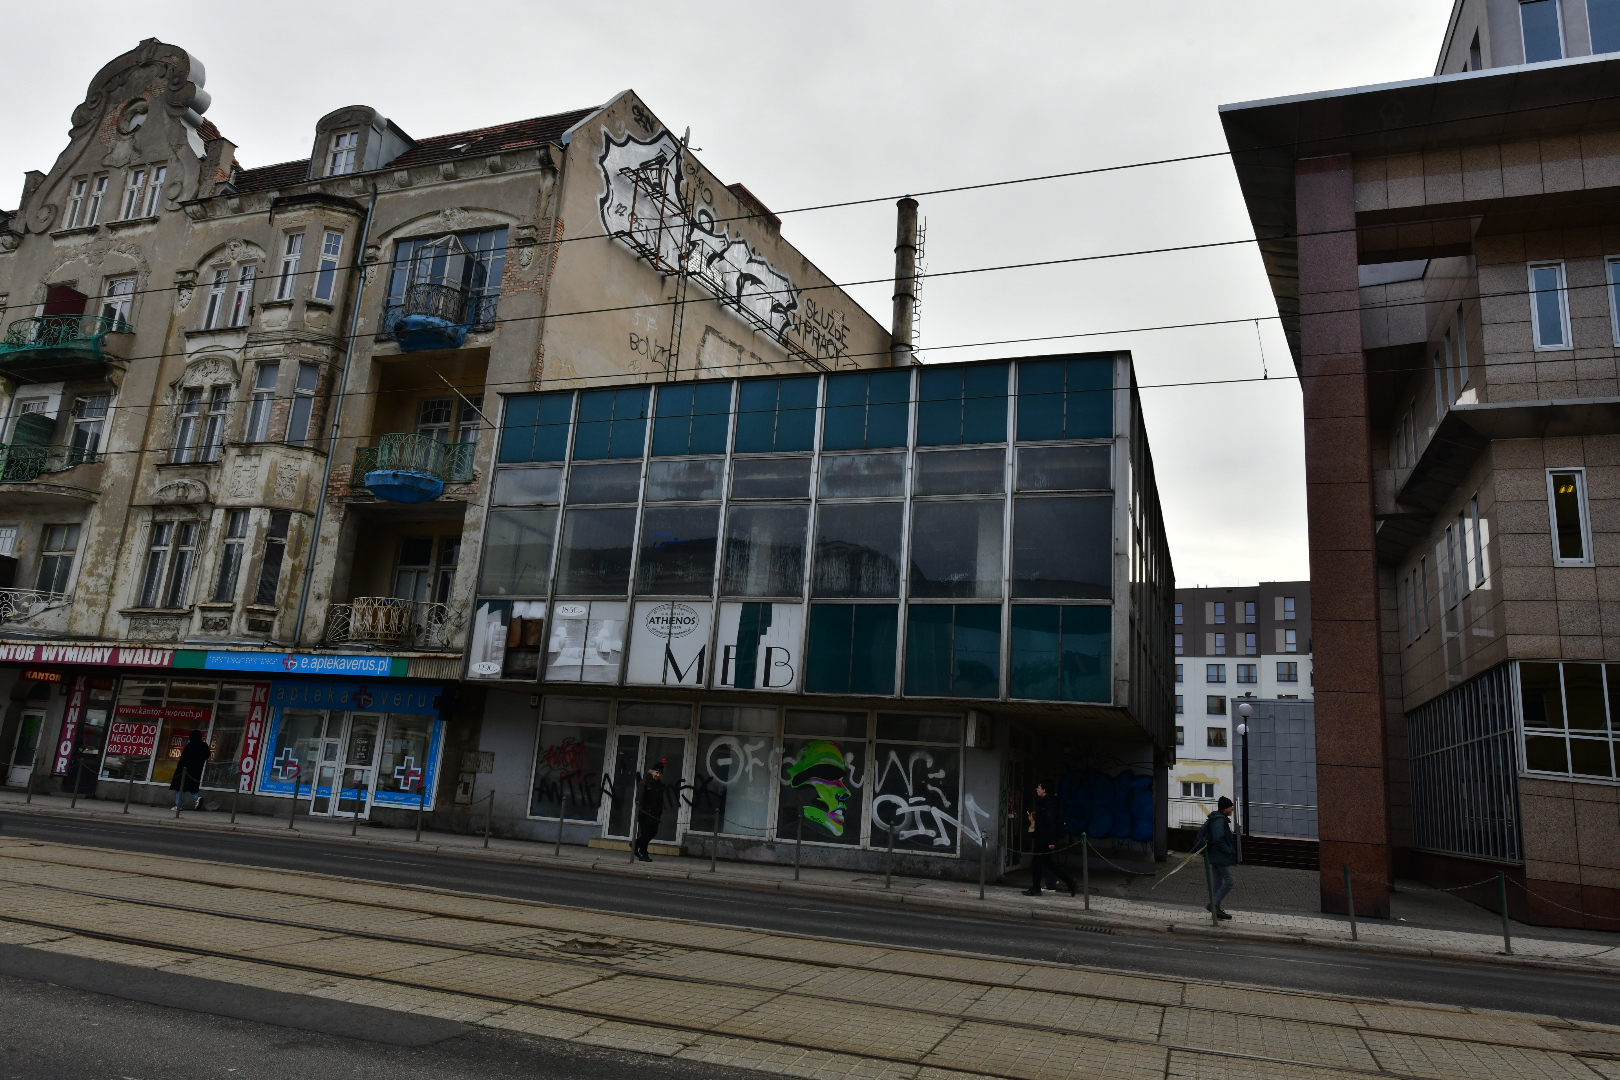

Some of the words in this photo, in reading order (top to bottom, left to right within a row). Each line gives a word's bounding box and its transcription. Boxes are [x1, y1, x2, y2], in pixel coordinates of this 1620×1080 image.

[648, 616, 696, 625] ATHENOS
[41, 645, 114, 663] WYMIANY
[118, 648, 174, 666] WALUT
[301, 656, 389, 674] e.aptekaverus.pl
[25, 670, 62, 682] KANTOR
[276, 686, 350, 704] apteka
[56, 675, 87, 773] KANTOR
[112, 723, 139, 734] CENY
[141, 724, 157, 735] DO
[239, 687, 268, 791] KANTOR
[107, 744, 121, 753] 602
[122, 745, 137, 755] 517
[137, 746, 152, 756] 390
